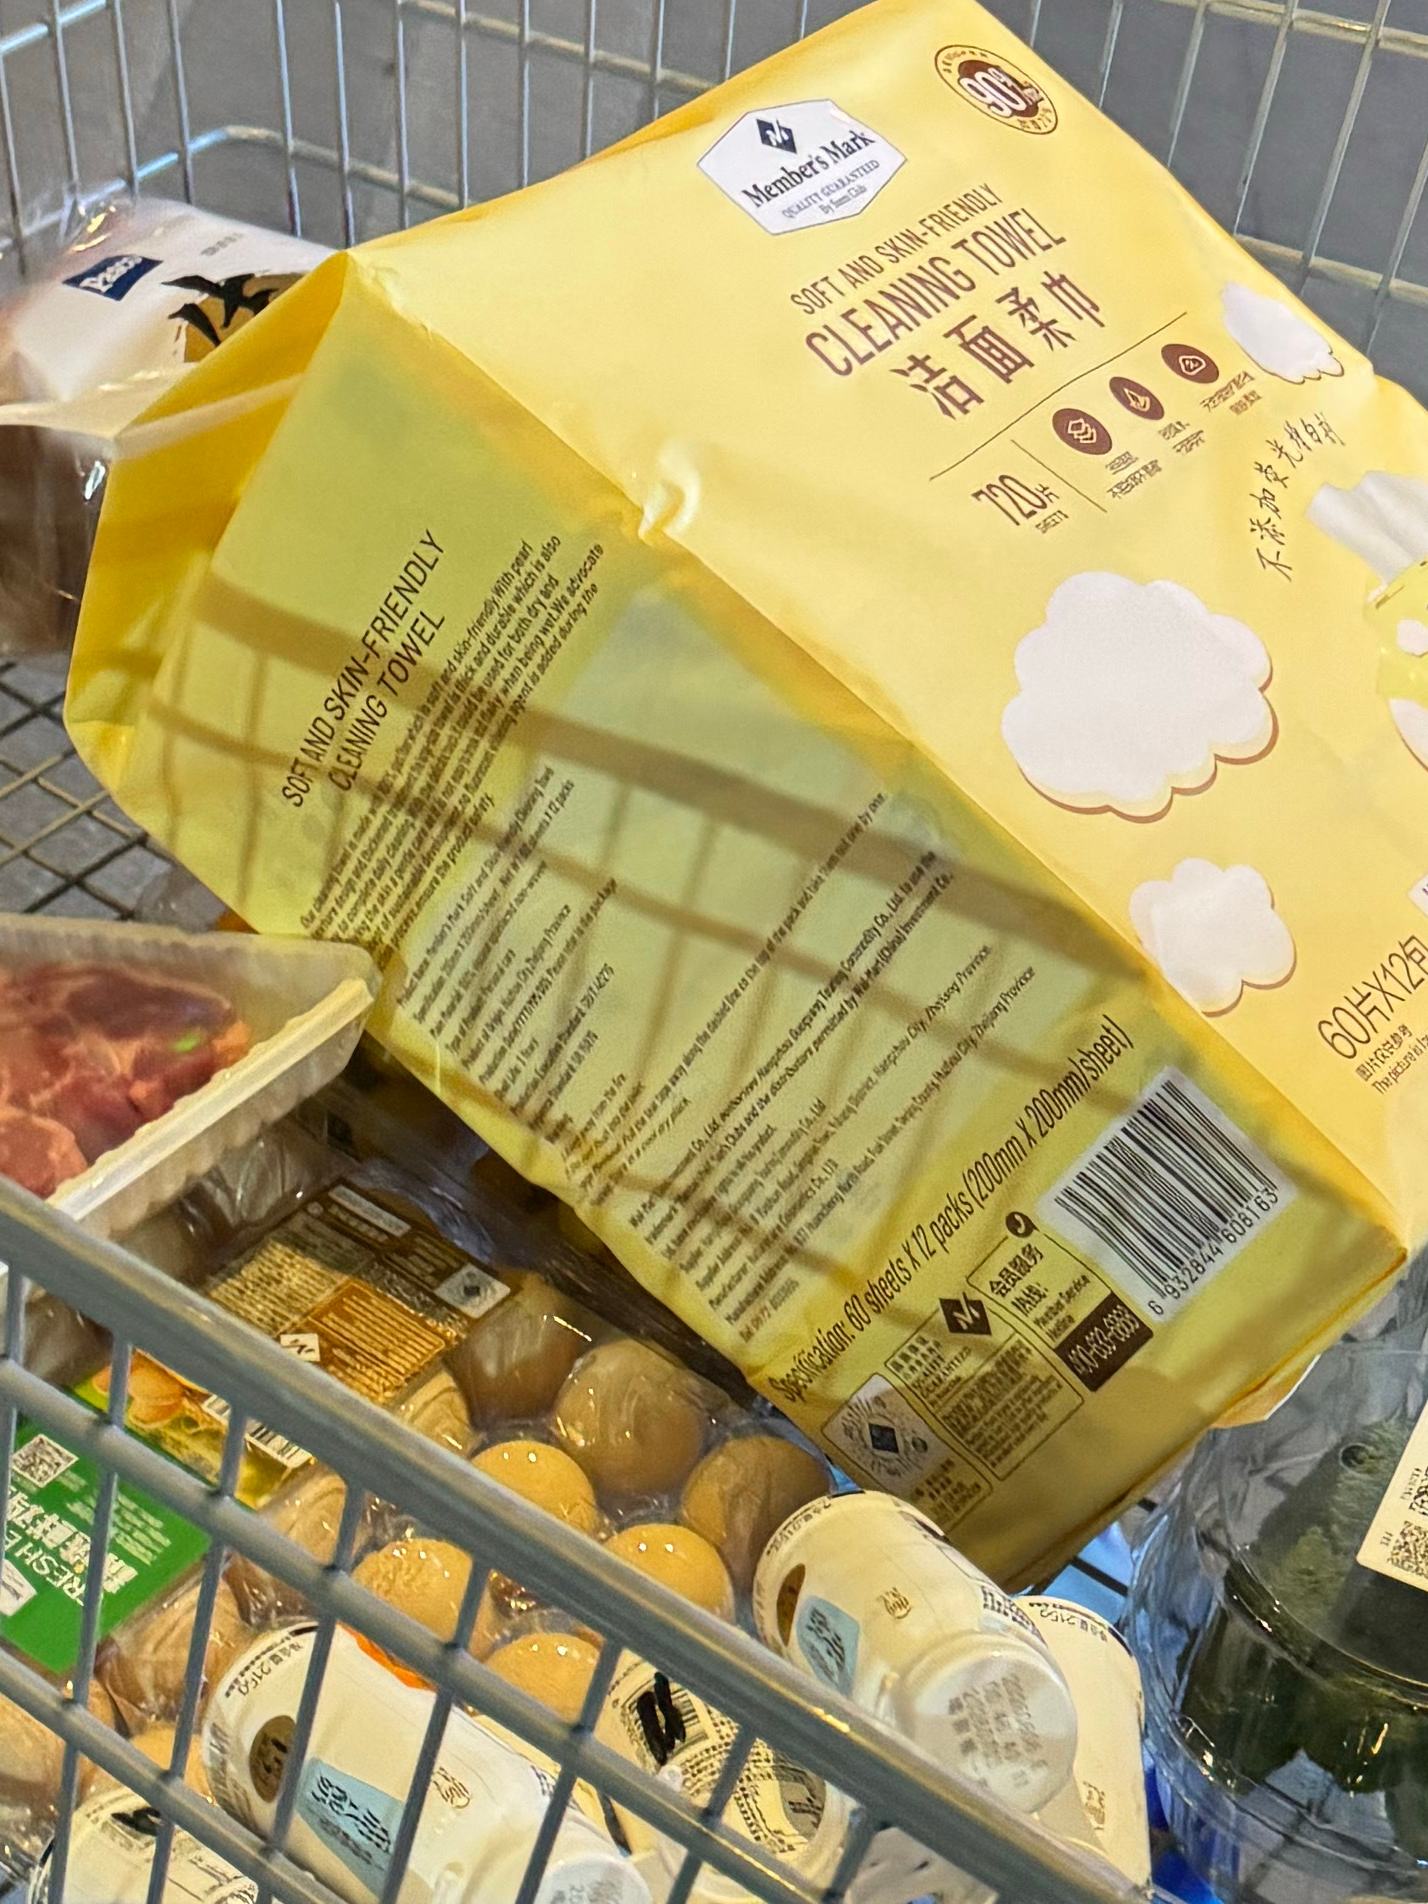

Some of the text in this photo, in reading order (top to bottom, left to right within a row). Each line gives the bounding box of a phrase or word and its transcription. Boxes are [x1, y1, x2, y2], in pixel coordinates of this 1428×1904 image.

[742, 129, 876, 209] Member's Mark
[790, 182, 1003, 315] SOFT AND SKIN-FRIENDLY
[805, 208, 1066, 377] CLEANING TOWEL
[889, 270, 1106, 421] 洁面柔巾
[972, 474, 1060, 527] 720片
[510, 540, 533, 576] pearl
[472, 642, 491, 668] and
[485, 603, 517, 646] durable
[512, 571, 538, 605] which
[530, 559, 546, 573] is
[540, 535, 561, 562] also
[496, 641, 516, 662] for
[507, 617, 533, 645] both
[526, 597, 548, 619] dry
[539, 574, 560, 600] and
[501, 664, 523, 697] when
[516, 634, 545, 668] being
[566, 544, 604, 597] advocate
[536, 635, 562, 675] added
[558, 603, 588, 640] during
[581, 583, 598, 604] the
[282, 528, 445, 808] SOFT AND SKIN-FRIENDLY
[327, 610, 446, 793] CLEANING TOWEL
[554, 779, 575, 808] packs
[1025, 1017, 1132, 1136] 200mm/sheet)
[963, 1136, 1026, 1208] (200mm
[1015, 1117, 1038, 1150] X
[901, 1243, 921, 1271] X
[911, 1224, 937, 1260] 12
[930, 1192, 974, 1252] packs
[1147, 1186, 1278, 1316] 6 932844 608163
[843, 1294, 871, 1332] 60
[864, 1258, 912, 1314] sheets
[15, 1537, 85, 1605] RESH
